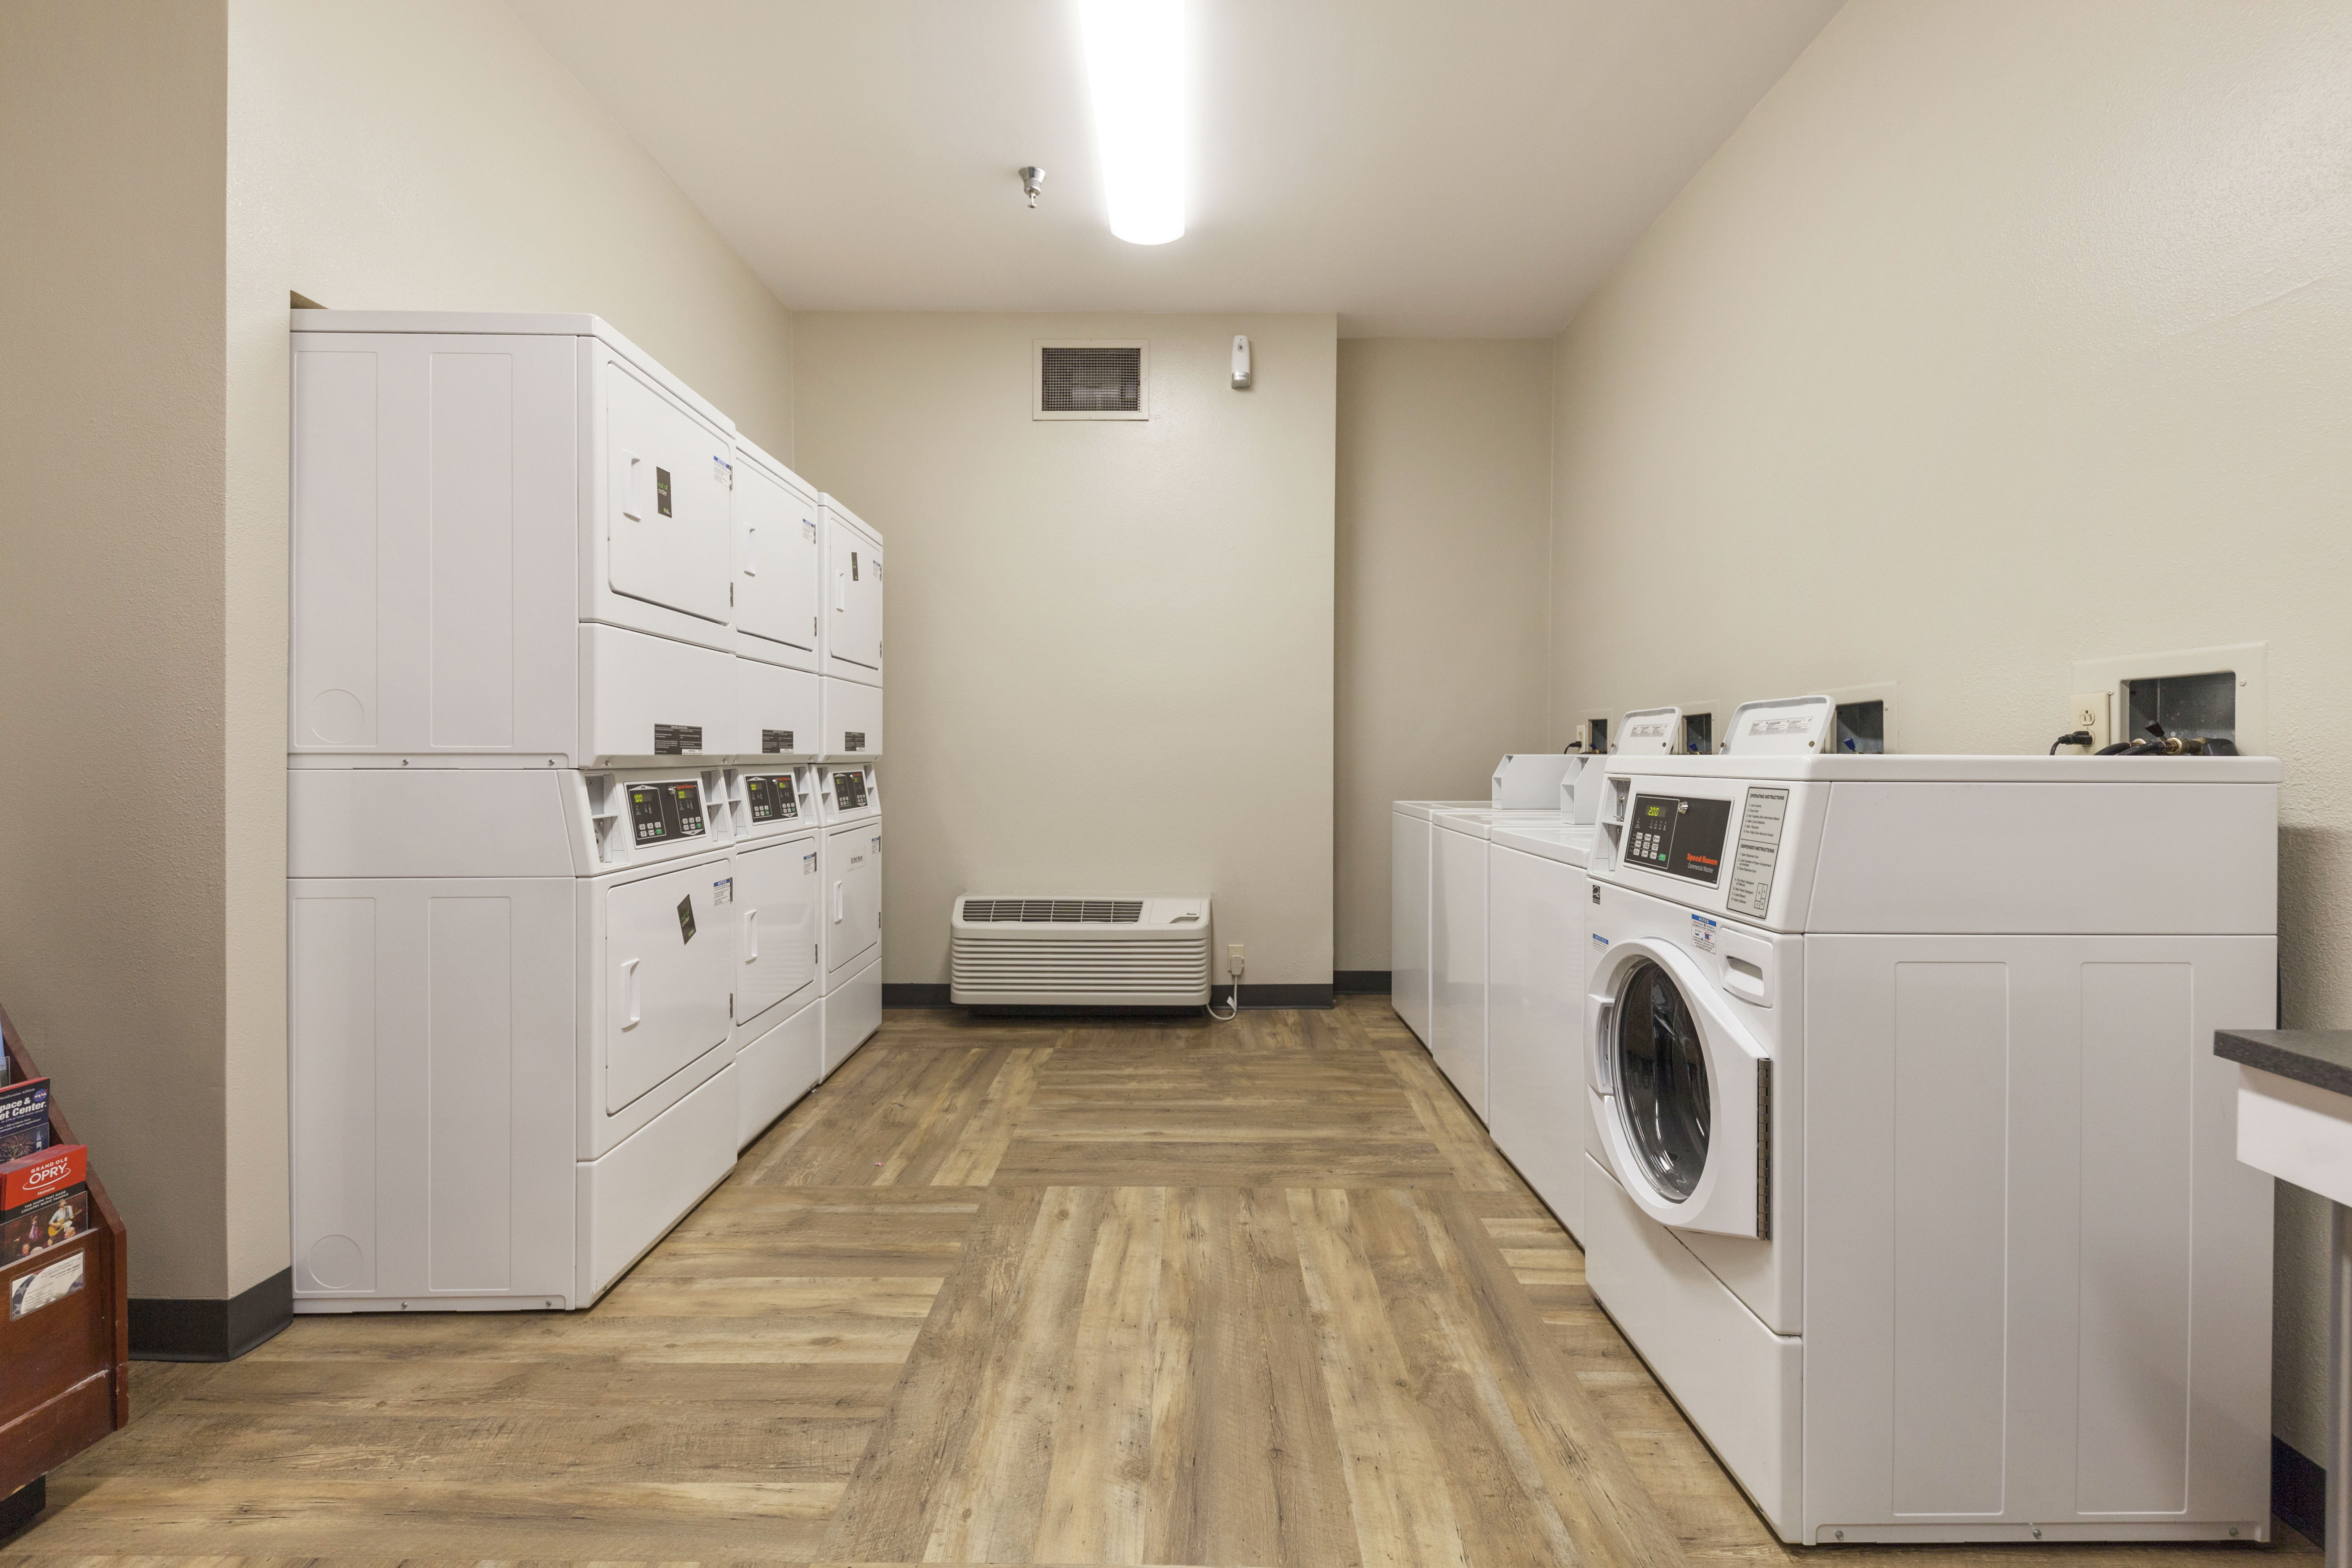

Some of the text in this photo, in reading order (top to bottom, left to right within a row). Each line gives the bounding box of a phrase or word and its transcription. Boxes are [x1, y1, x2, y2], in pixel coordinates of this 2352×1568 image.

[658, 488, 667, 496] order
[1687, 853, 1718, 866] Speed Queen
[1688, 863, 1703, 871] Commercial
[681, 916, 689, 927] order
[1595, 934, 1607, 943] NOTICE
[12, 1101, 46, 1116] Center
[31, 1162, 54, 1173] GRAND
[29, 1163, 67, 1184] OPRY
[38, 1187, 55, 1196] Humana
[22, 1205, 40, 1213] COUNTRY
[53, 1193, 69, 1201] FAMOUS
